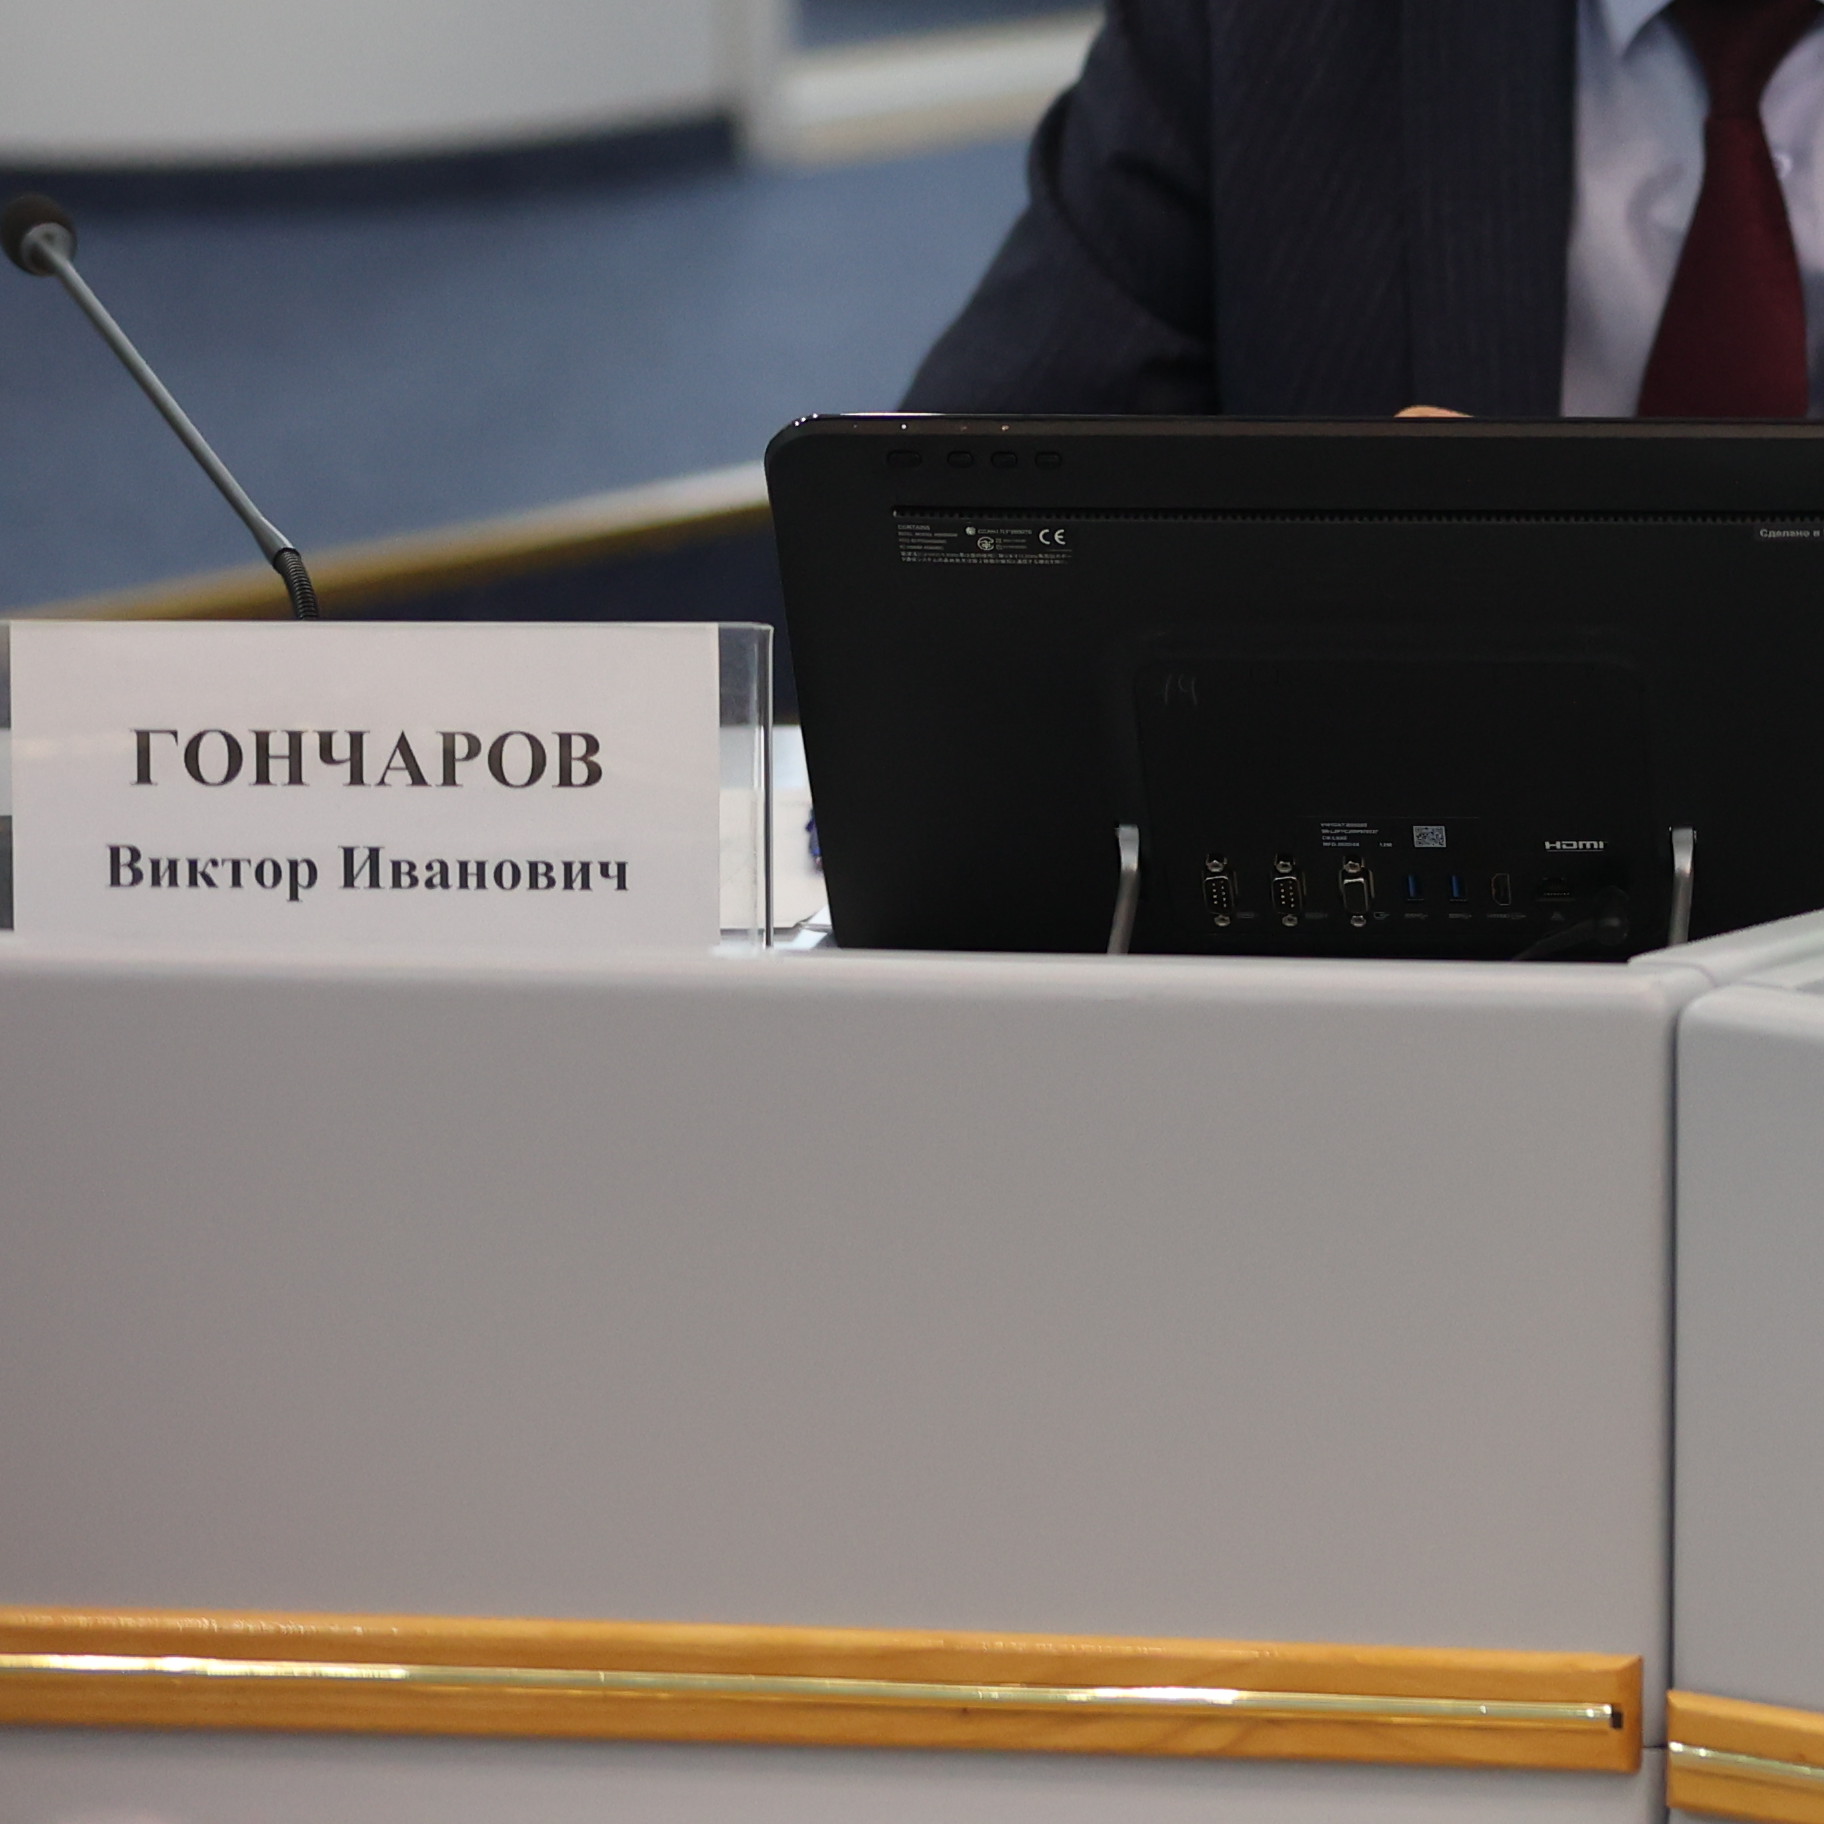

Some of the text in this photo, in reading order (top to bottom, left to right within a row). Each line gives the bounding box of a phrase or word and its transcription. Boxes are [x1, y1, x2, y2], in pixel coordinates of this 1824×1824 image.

[1759, 528, 1810, 538] Сделано
[130, 728, 604, 789] ГОНЧАРОВ
[1544, 840, 1604, 850] HDMI
[107, 844, 630, 903] Виктор Иванович
